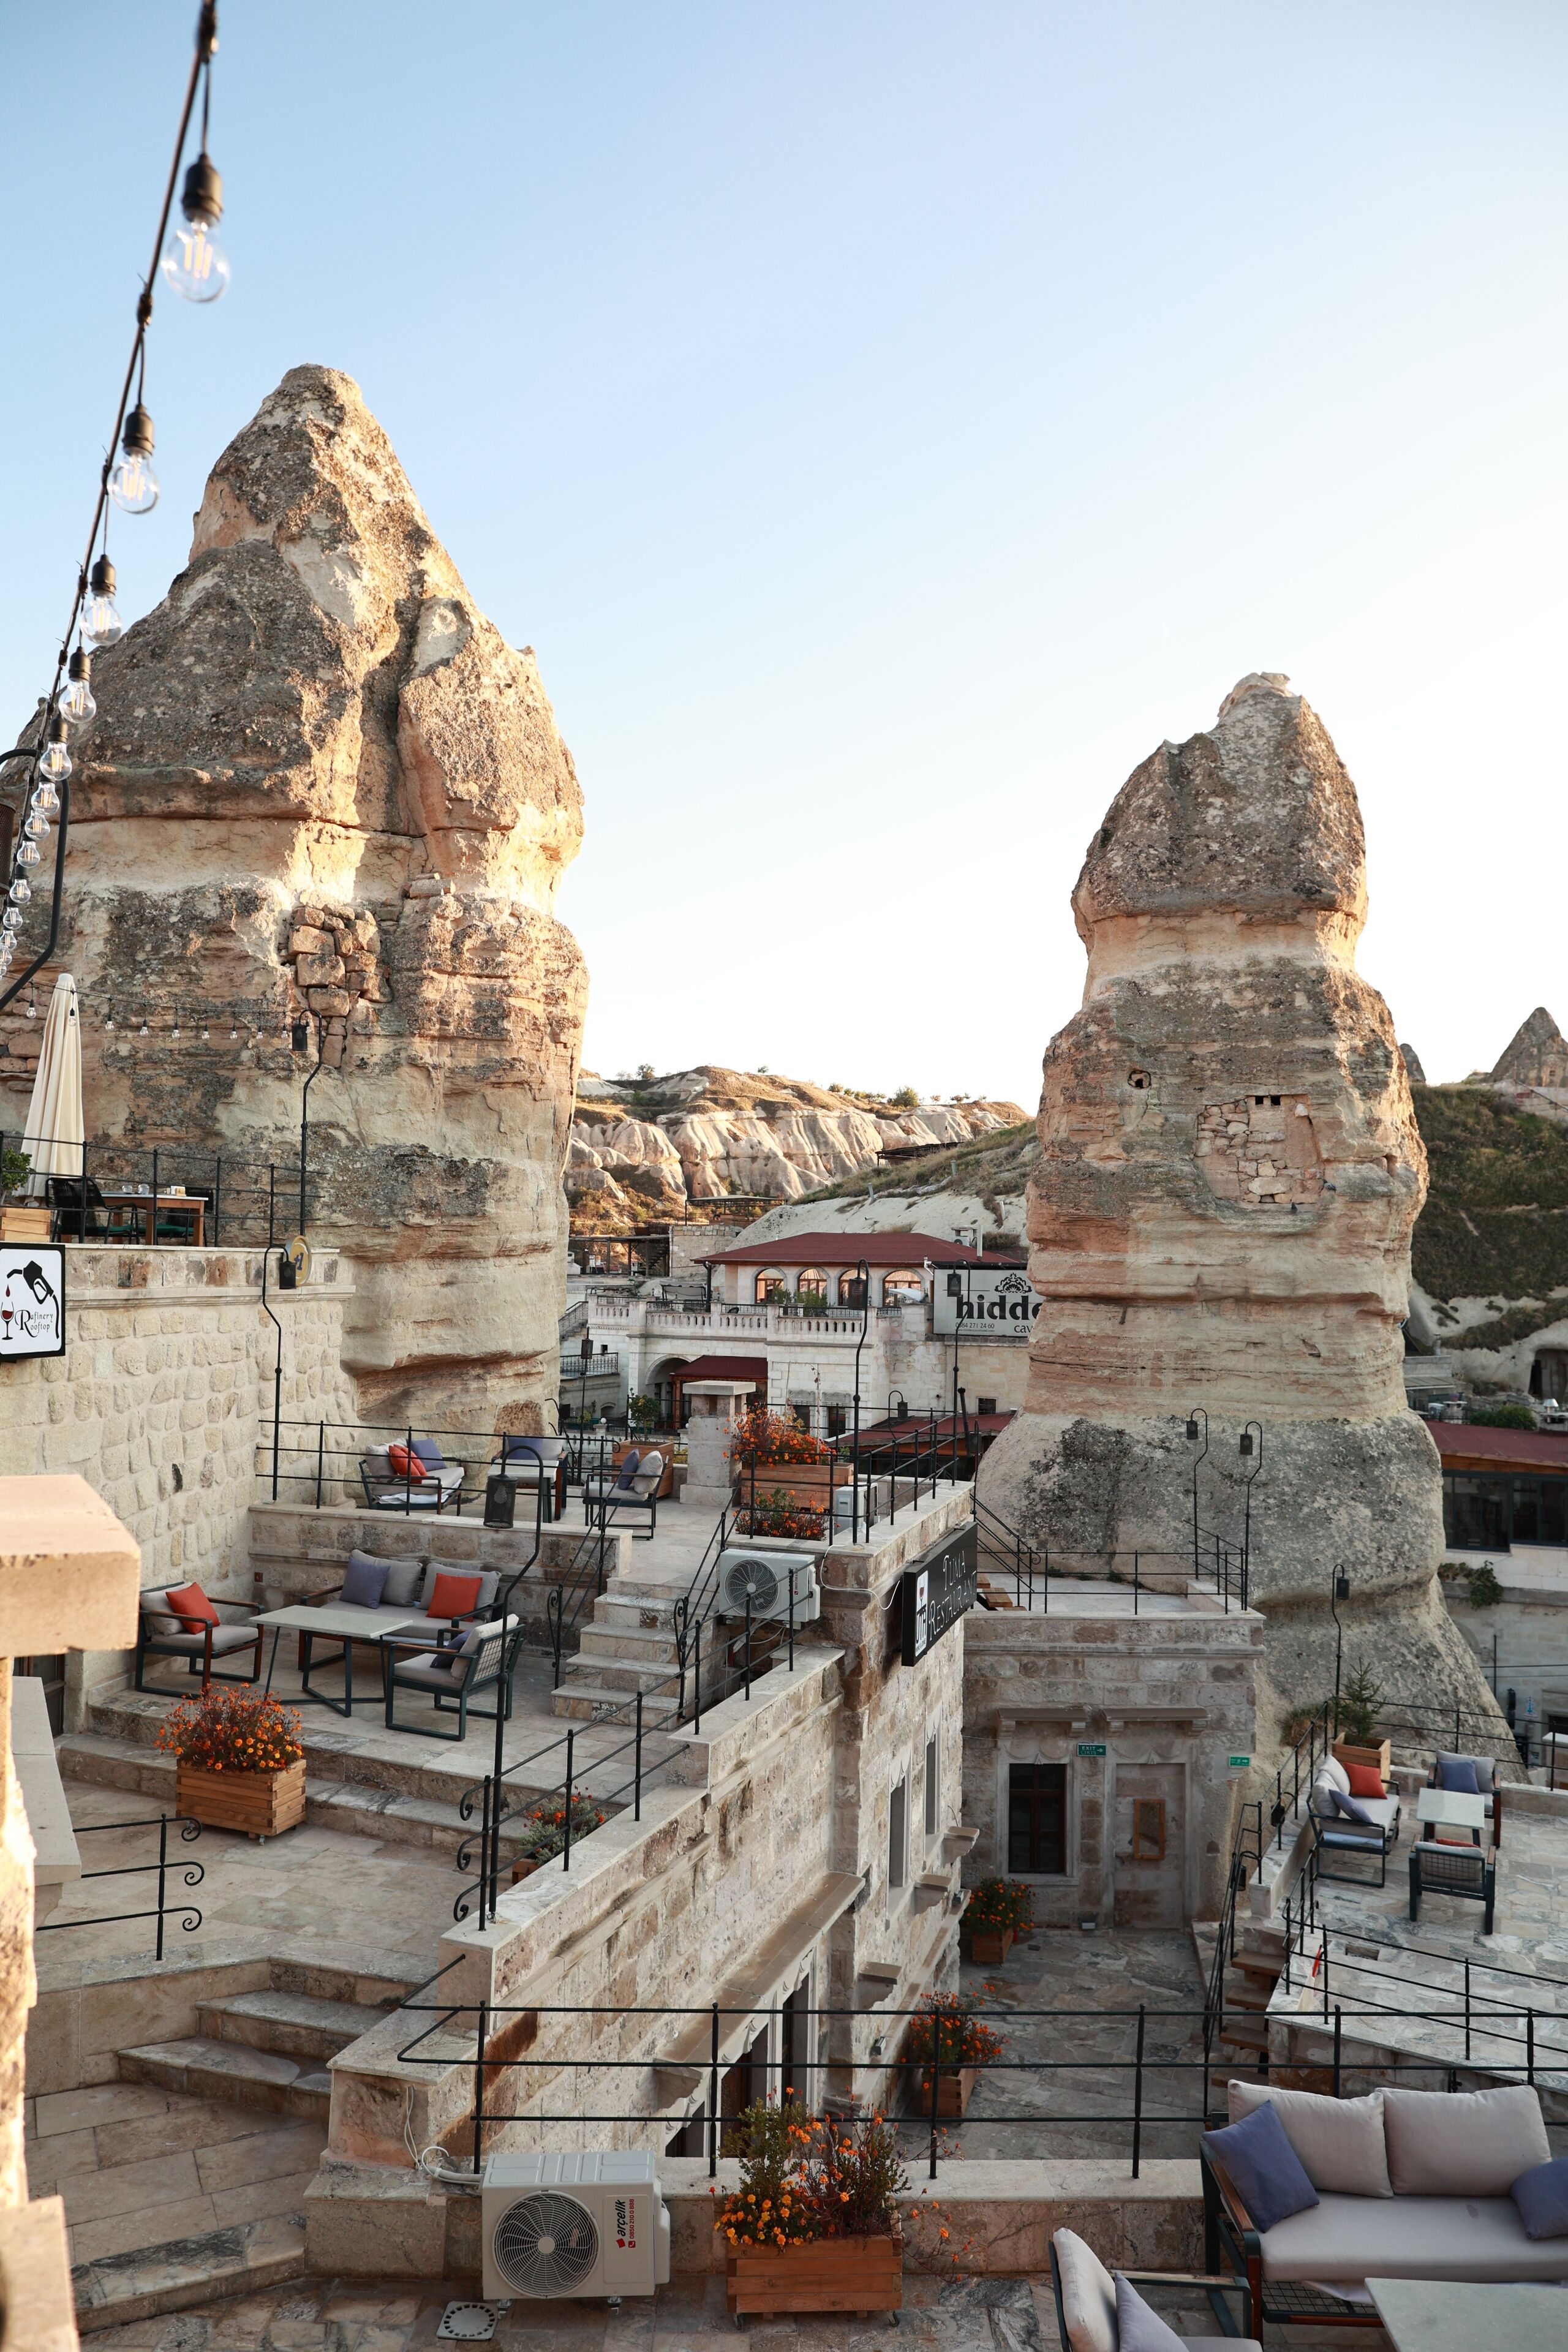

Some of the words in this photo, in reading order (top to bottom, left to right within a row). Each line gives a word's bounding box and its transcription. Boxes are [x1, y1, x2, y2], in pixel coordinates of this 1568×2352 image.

[15, 1310, 53, 1338] Rafinery
[943, 1550, 966, 1591] TUMA
[929, 1570, 977, 1641] RESTAURANT
[615, 2199, 628, 2237] arçelik
